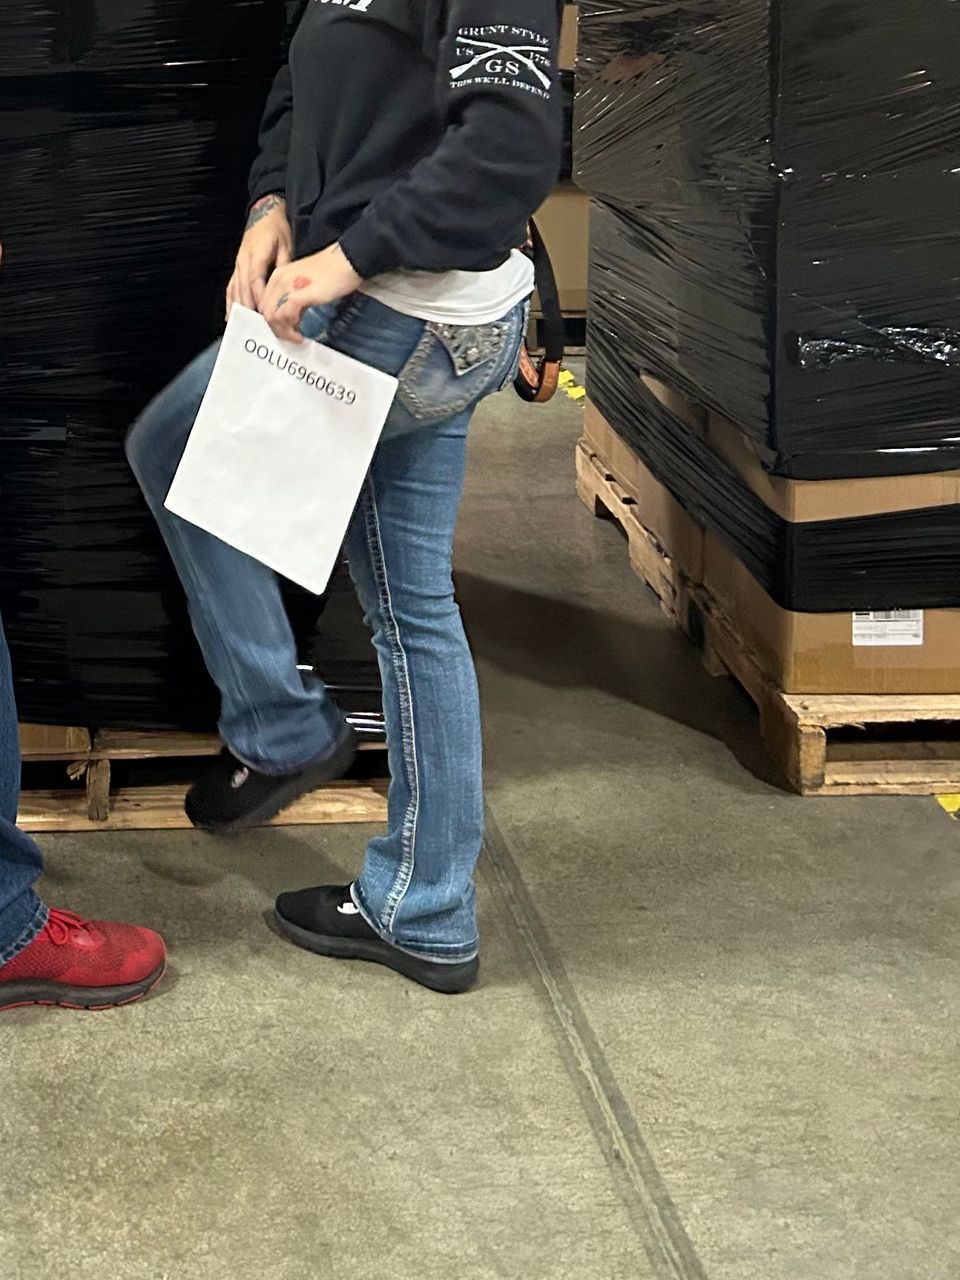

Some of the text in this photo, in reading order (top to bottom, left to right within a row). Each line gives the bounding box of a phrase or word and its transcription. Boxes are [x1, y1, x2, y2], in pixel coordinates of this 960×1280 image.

[458, 25, 550, 46] GRUNT STYLE
[485, 59, 519, 75] GS
[244, 338, 357, 406] OOLU6960639
